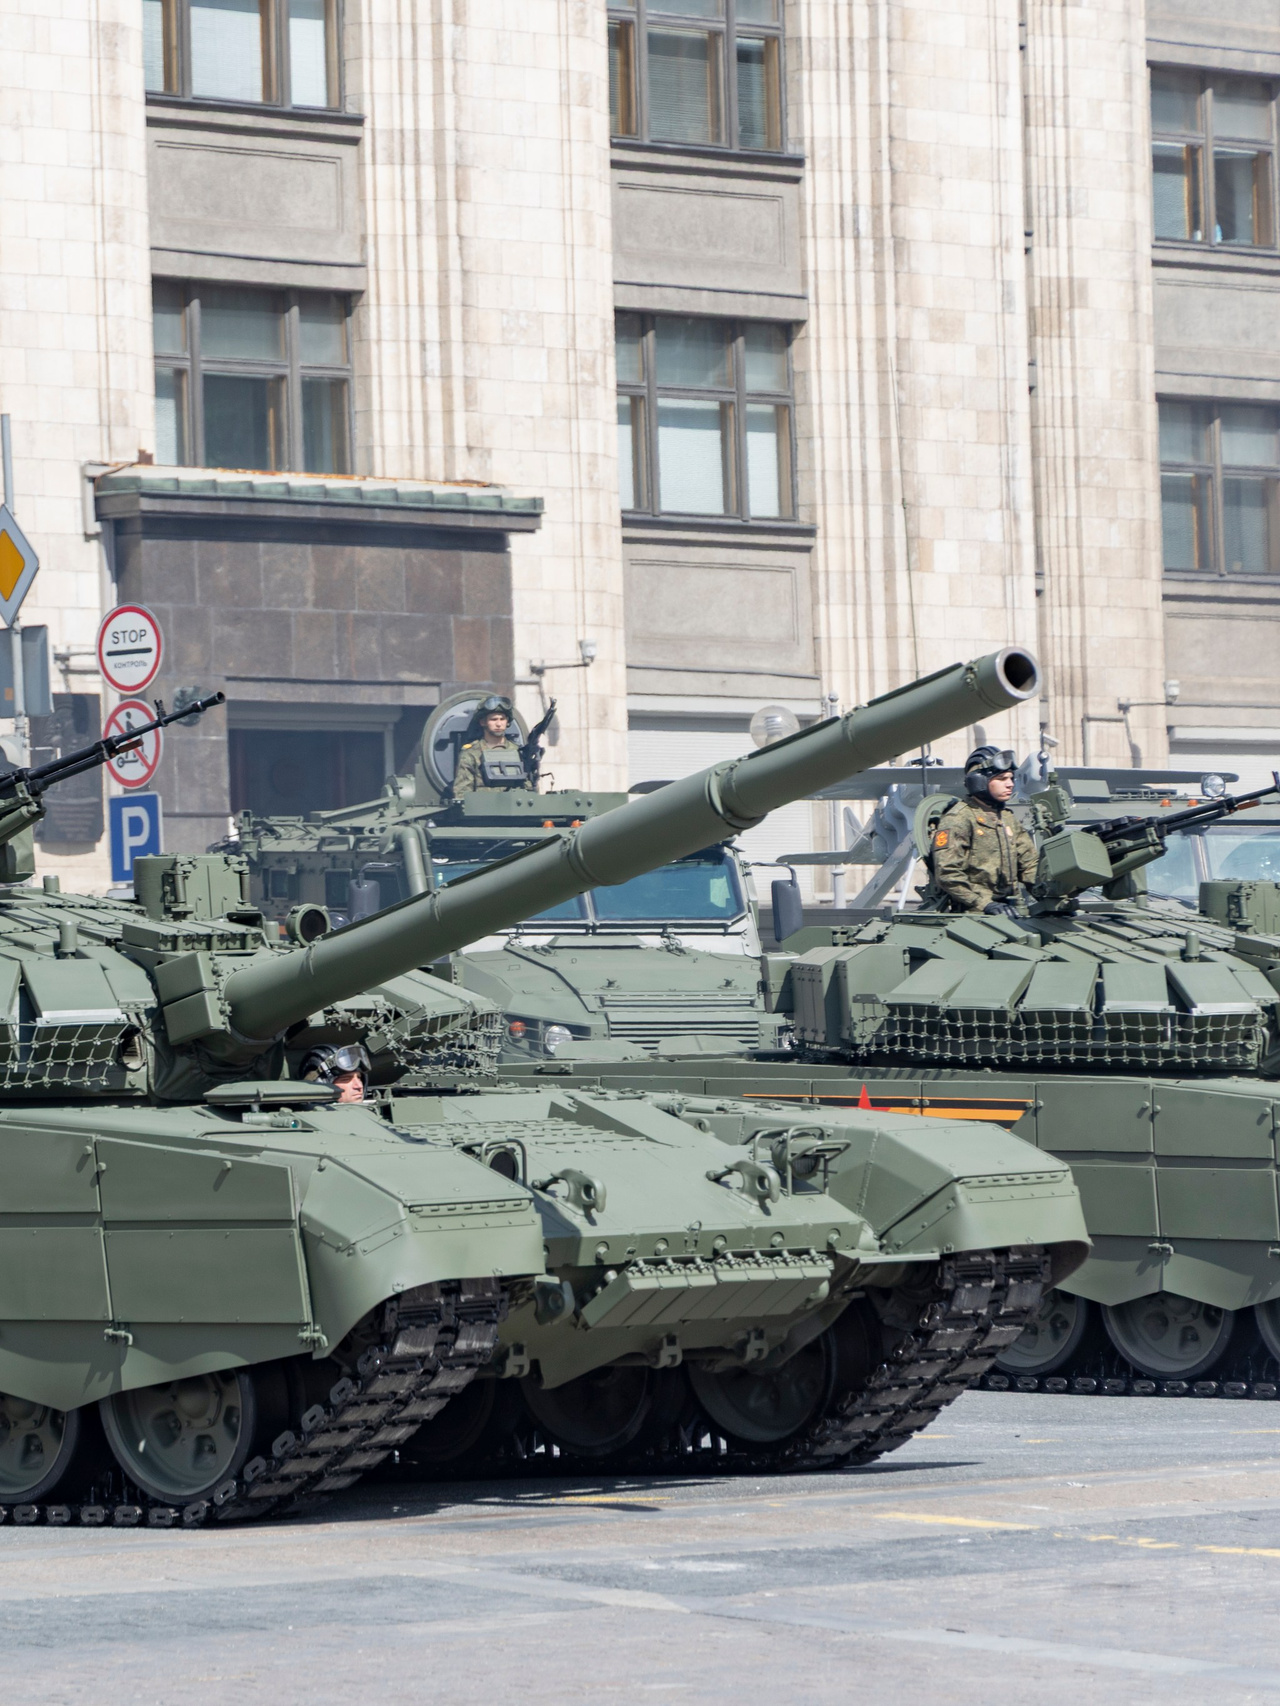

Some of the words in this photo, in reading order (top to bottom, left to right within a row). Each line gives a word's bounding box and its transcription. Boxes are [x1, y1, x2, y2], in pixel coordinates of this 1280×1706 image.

[111, 629, 147, 645] STOP
[114, 660, 147, 669] КОНТРОЛЬ
[121, 805, 151, 871] P
